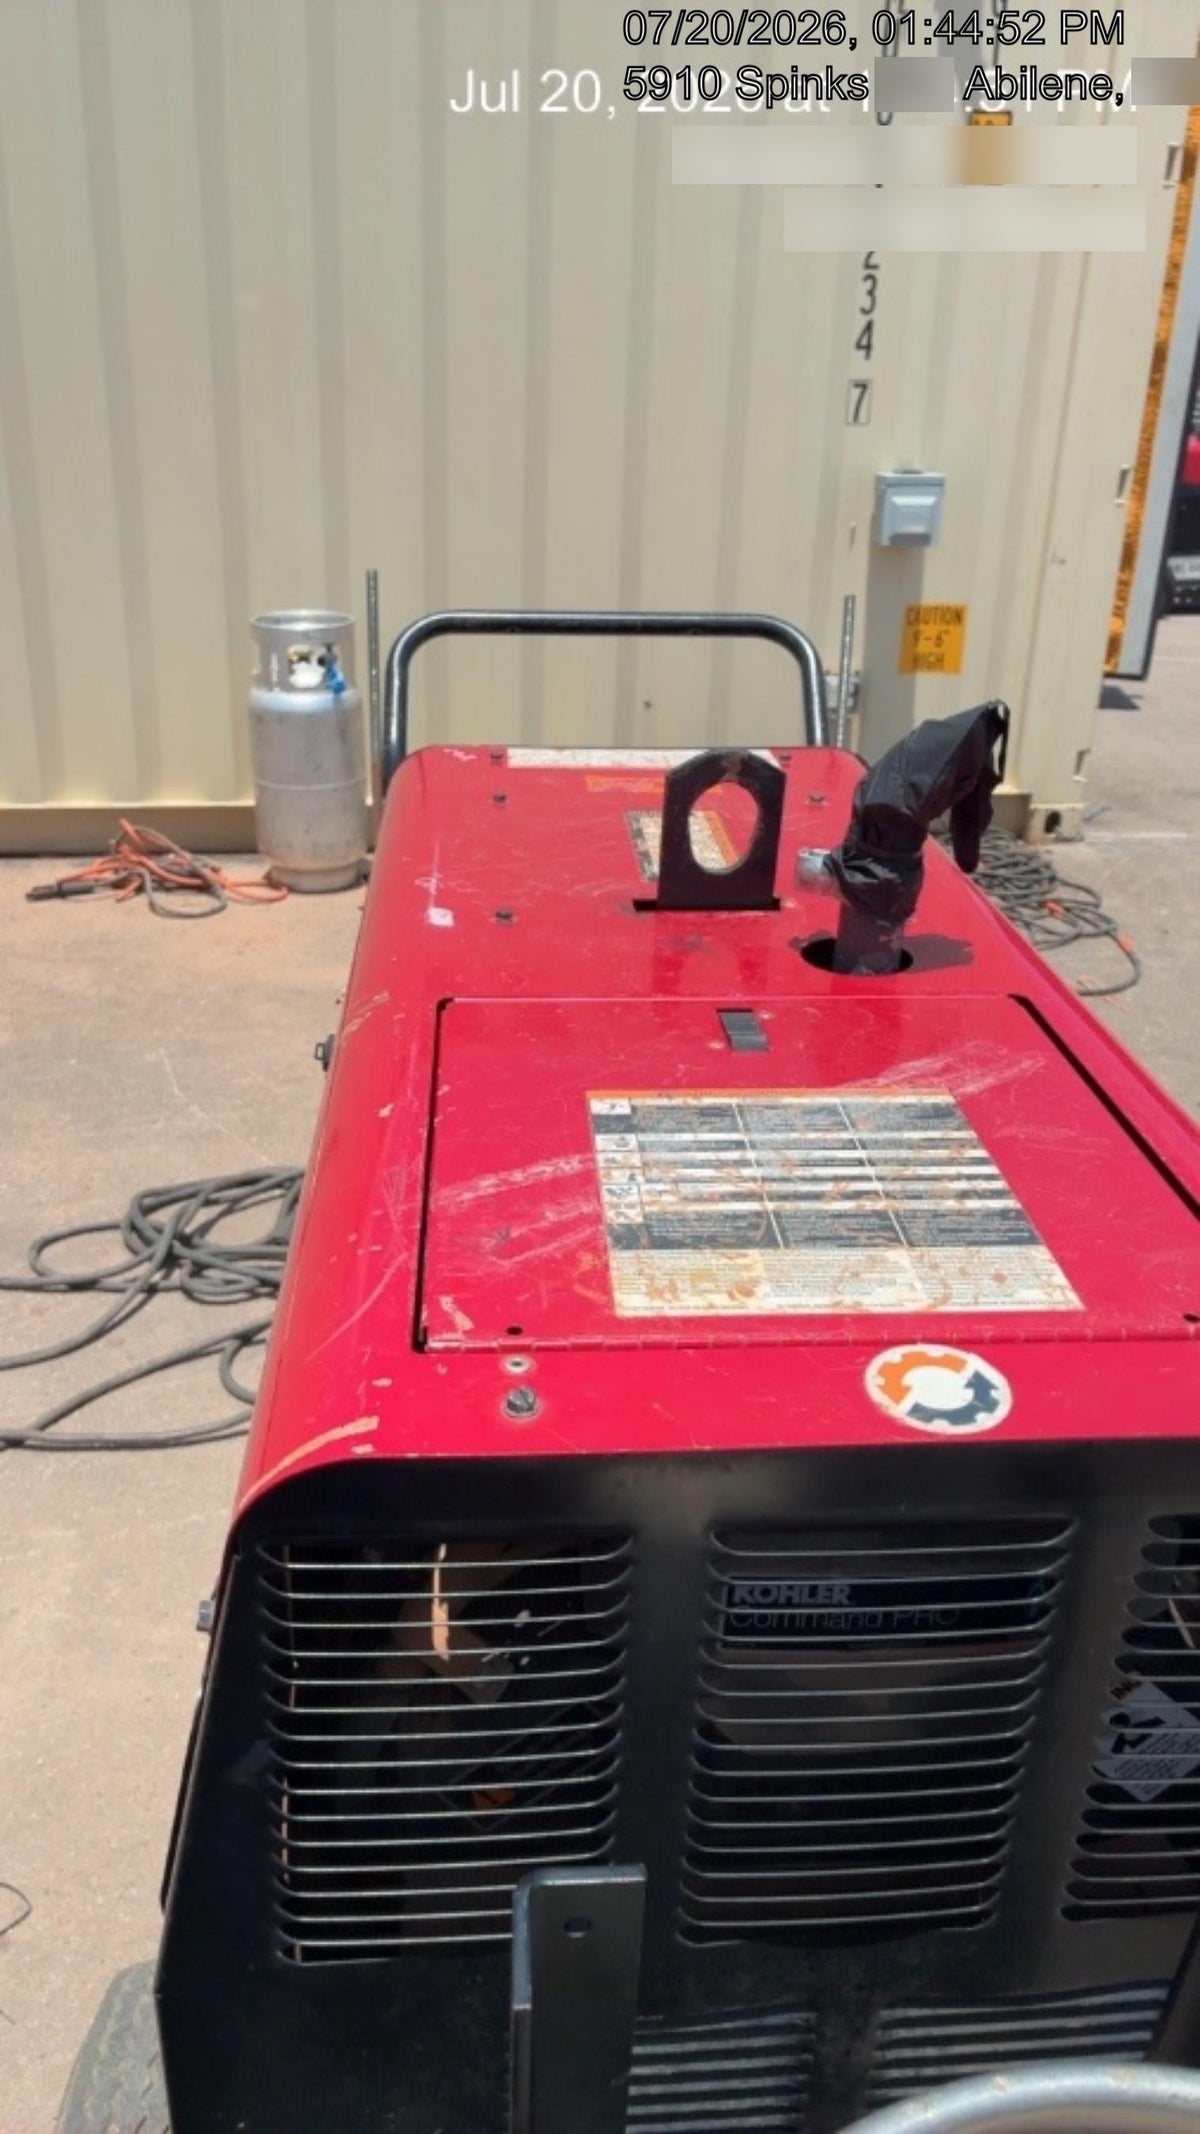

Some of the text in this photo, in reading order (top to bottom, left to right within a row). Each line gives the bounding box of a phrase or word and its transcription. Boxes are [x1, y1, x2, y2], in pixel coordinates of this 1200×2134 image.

[852, 382, 869, 424] 7
[904, 605, 964, 626] CAUTION
[734, 1583, 851, 1606] KOHLER
[730, 1604, 959, 1629] Command PRO
